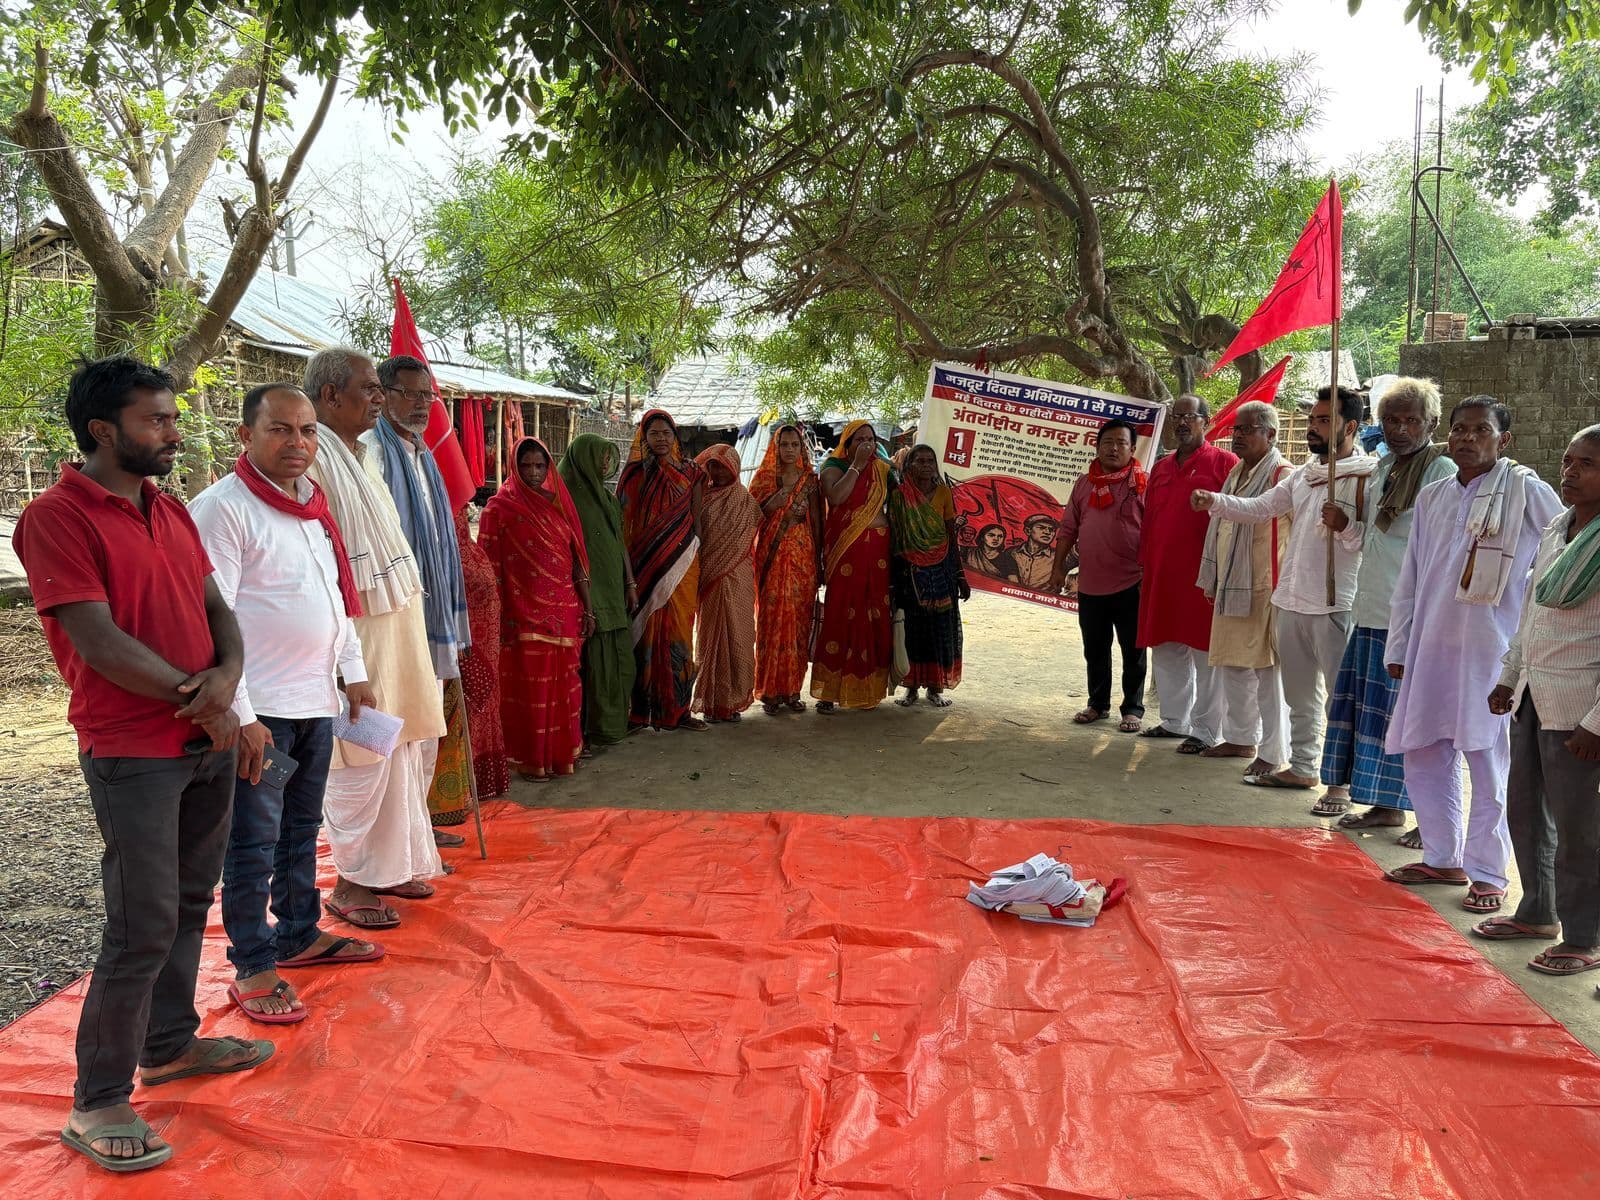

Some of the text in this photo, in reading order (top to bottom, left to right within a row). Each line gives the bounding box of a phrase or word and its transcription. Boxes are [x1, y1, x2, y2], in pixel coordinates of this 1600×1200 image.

[945, 374, 1149, 420] मजदूर दिवस अभियान 1 से 15 मई
[954, 392, 970, 403] मई
[973, 397, 1002, 410] दिवस
[1004, 402, 1016, 413] के
[1019, 407, 1054, 419] शहीदों
[1055, 412, 1072, 422] को
[1074, 416, 1101, 427] लाल
[952, 406, 1024, 433] अंतर्राष्ट्रीय
[1026, 423, 1080, 447] मजदूर
[953, 432, 965, 450] 1
[948, 451, 967, 465] मई
[1001, 586, 1034, 599] भाकपा
[1035, 594, 1059, 604] माले
